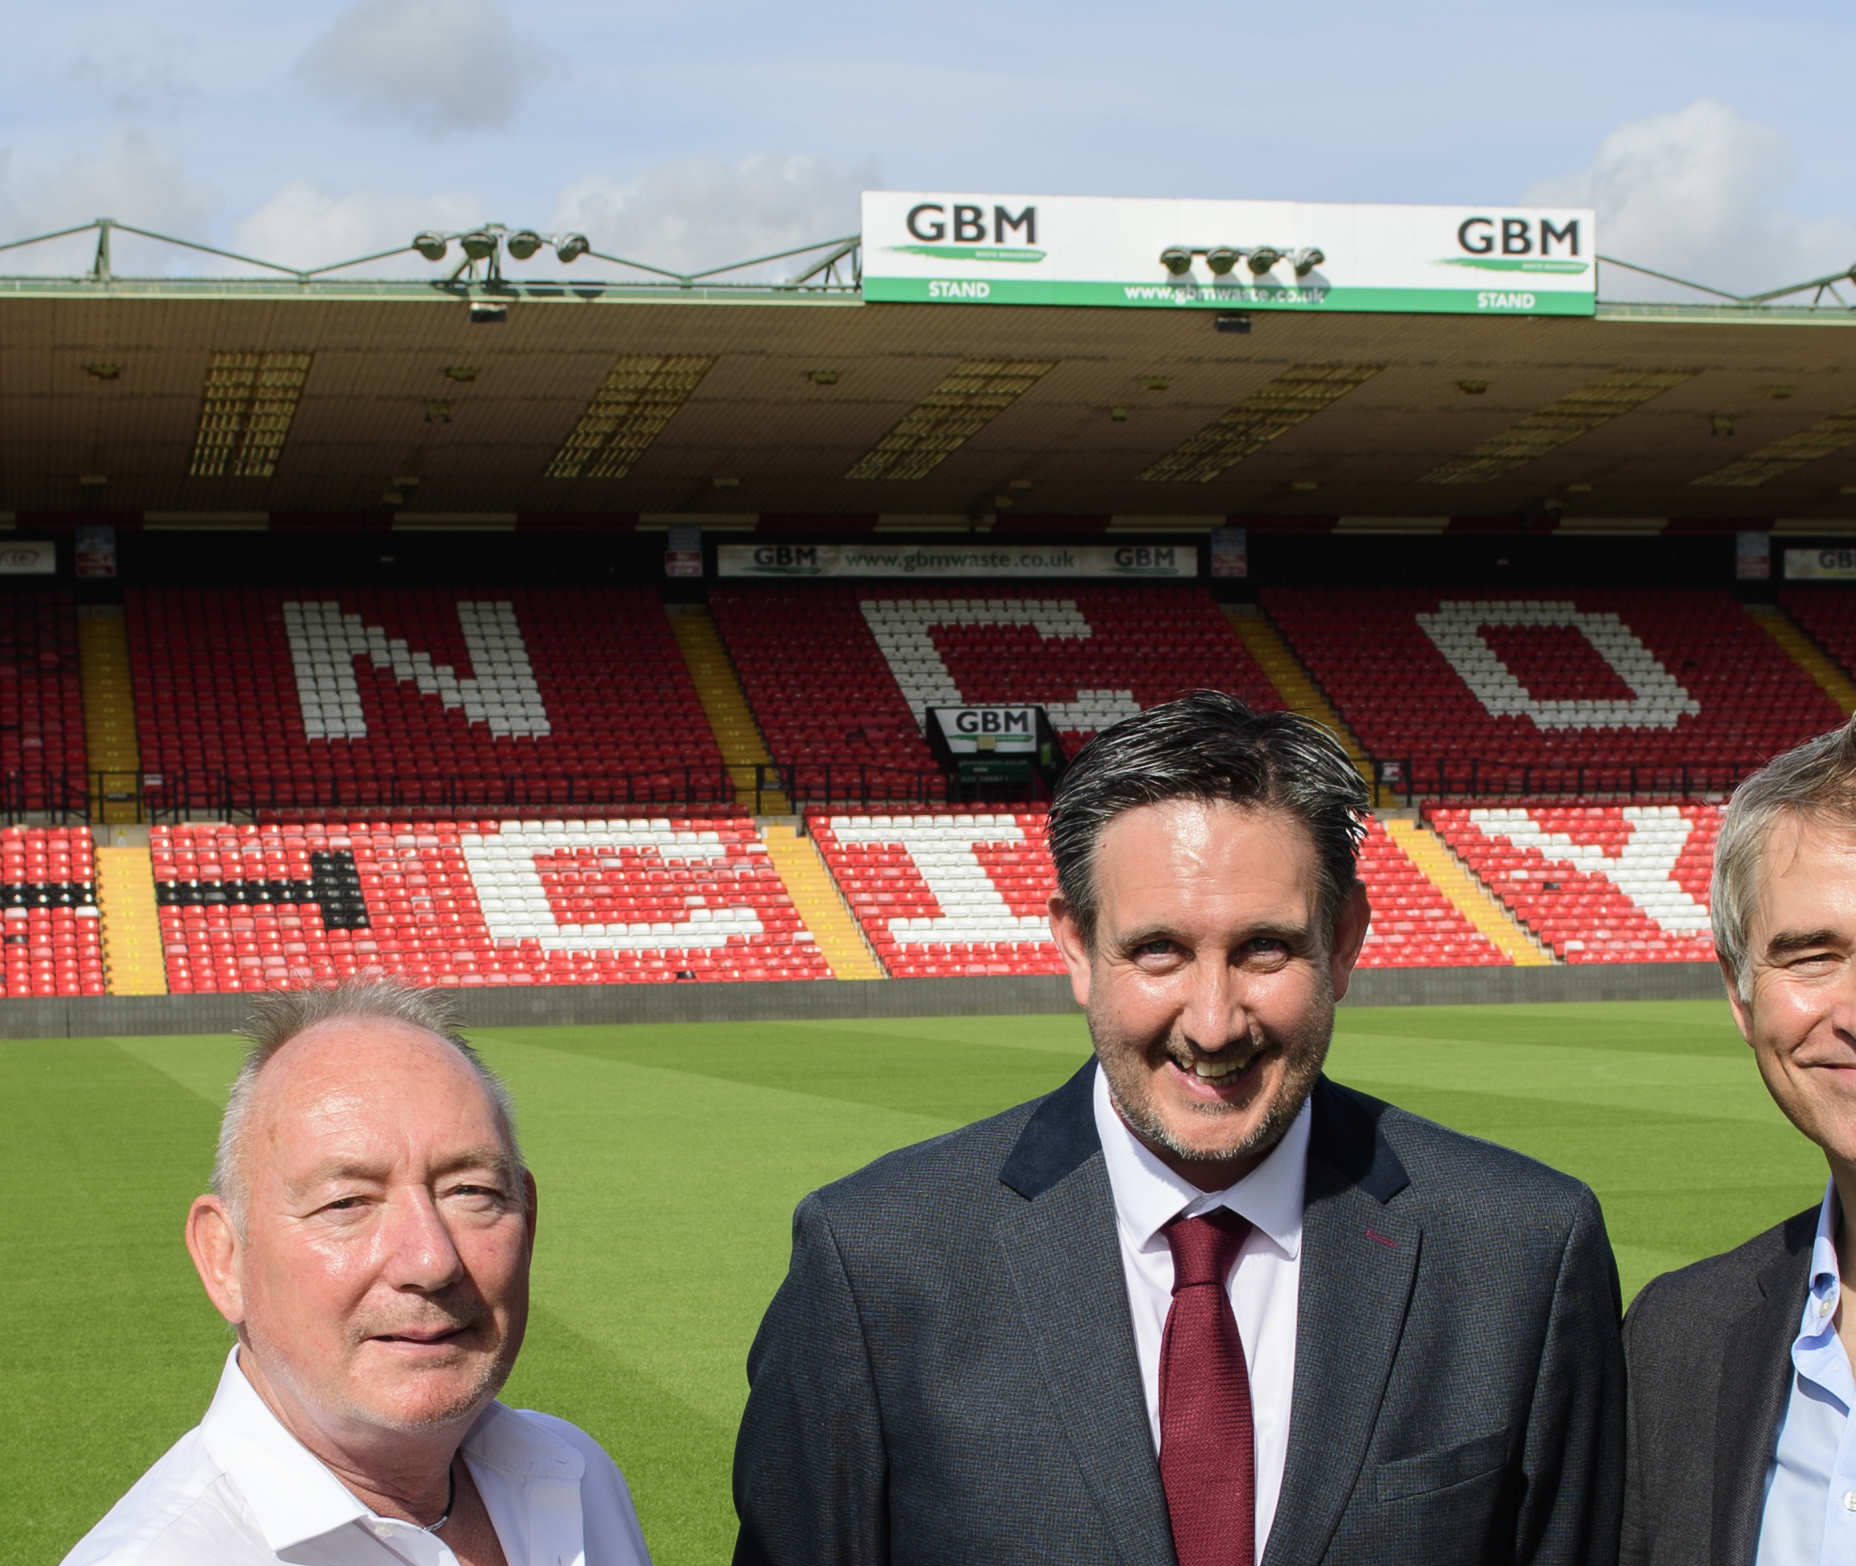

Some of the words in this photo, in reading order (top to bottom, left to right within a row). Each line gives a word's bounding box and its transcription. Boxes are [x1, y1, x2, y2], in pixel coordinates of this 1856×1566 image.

[907, 203, 1039, 245] GBM
[1457, 216, 1580, 257] GBM
[928, 281, 990, 298] STAND
[1124, 283, 1325, 304] www.gbmwaste.co.uk
[1477, 292, 1535, 309] STAND
[753, 546, 818, 566] GBM
[845, 549, 1075, 572] www.gbmwaste.co.uk
[1113, 547, 1176, 567] GBM
[955, 710, 1029, 733] GBM
